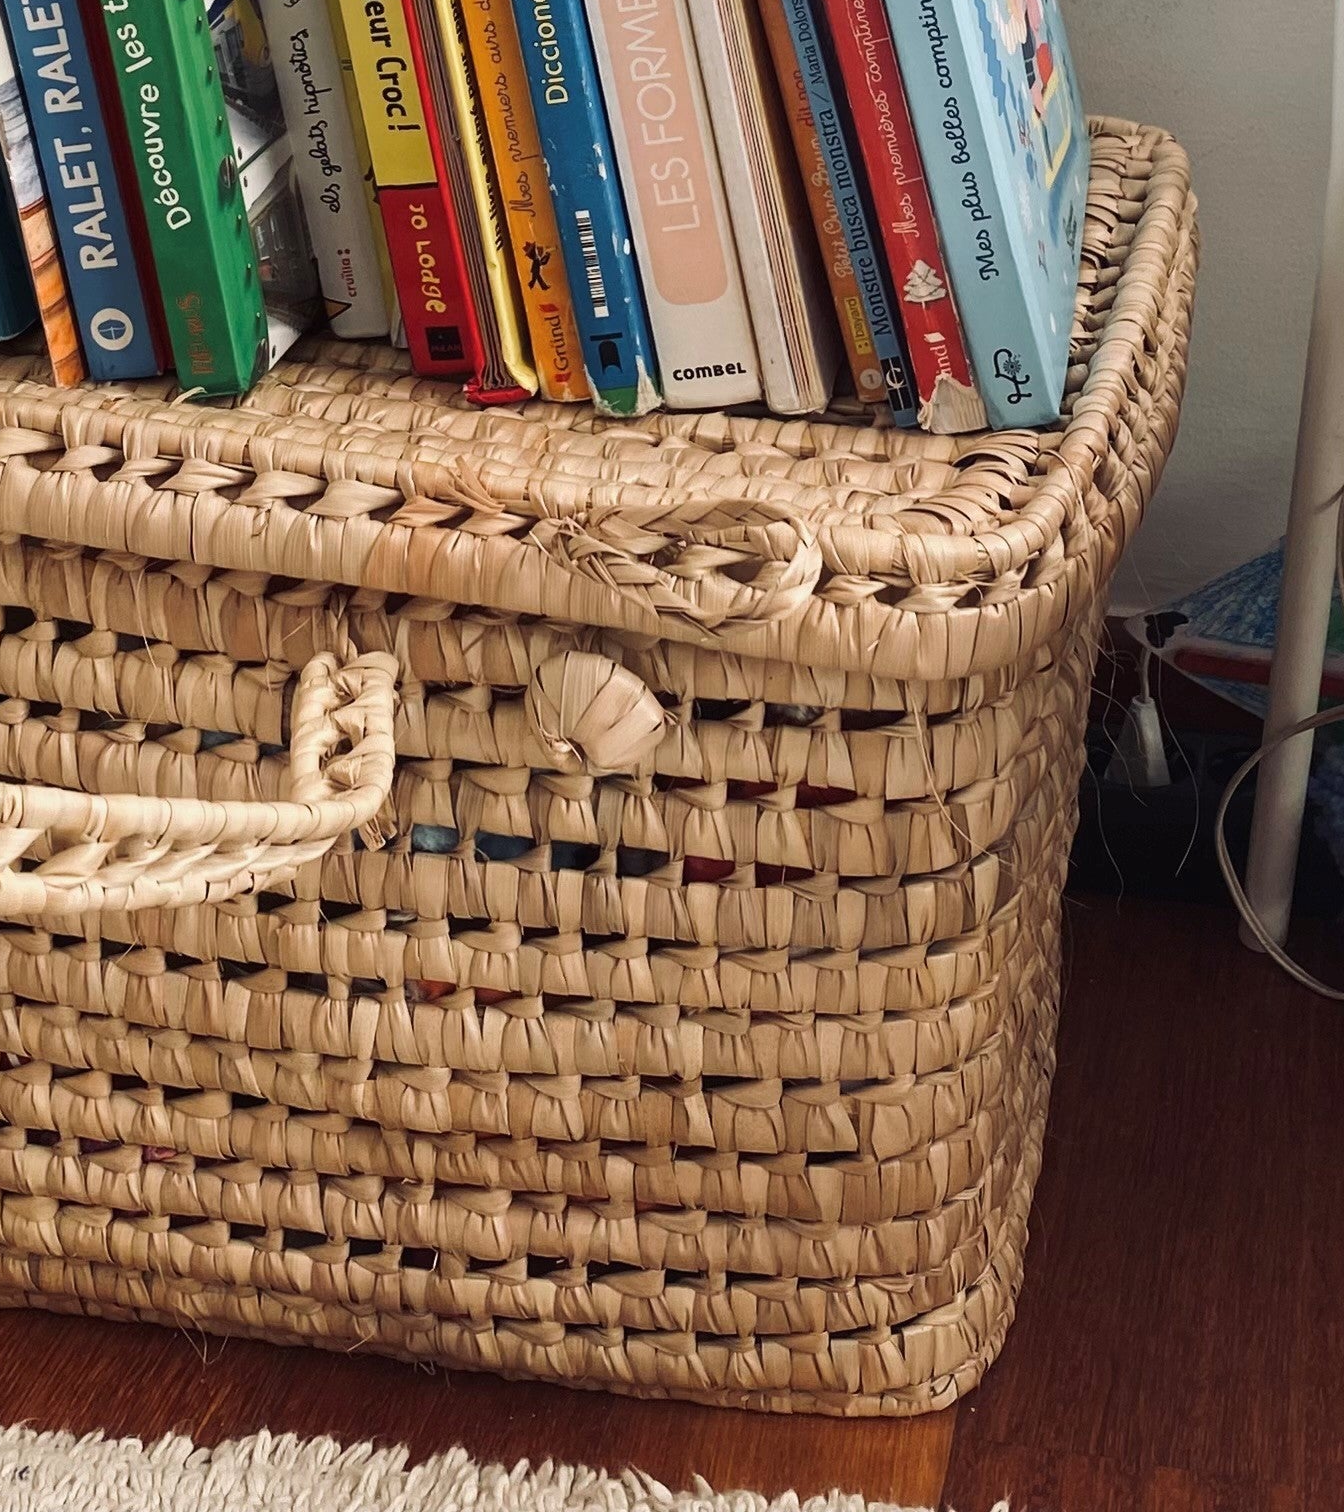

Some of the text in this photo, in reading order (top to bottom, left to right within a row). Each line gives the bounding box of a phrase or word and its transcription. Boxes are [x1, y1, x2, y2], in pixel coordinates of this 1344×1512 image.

[116, 22, 154, 74] les
[483, 19, 503, 64] airs
[804, 44, 826, 86] Maria
[289, 27, 343, 214] els gelats hipnòtics
[494, 71, 541, 163] premiers
[819, 108, 857, 190] monstra
[873, 90, 923, 186] premières
[942, 95, 971, 165] belles
[139, 81, 193, 232] Découvre
[53, 125, 119, 271] RALET,
[509, 170, 537, 218] Mes
[650, 156, 701, 233] LES
[840, 194, 867, 254] busca
[891, 192, 920, 238] Mes
[961, 171, 993, 222] plus
[974, 228, 1000, 282] Mes
[856, 256, 893, 337] Monstre
[543, 315, 569, 372] Gründ
